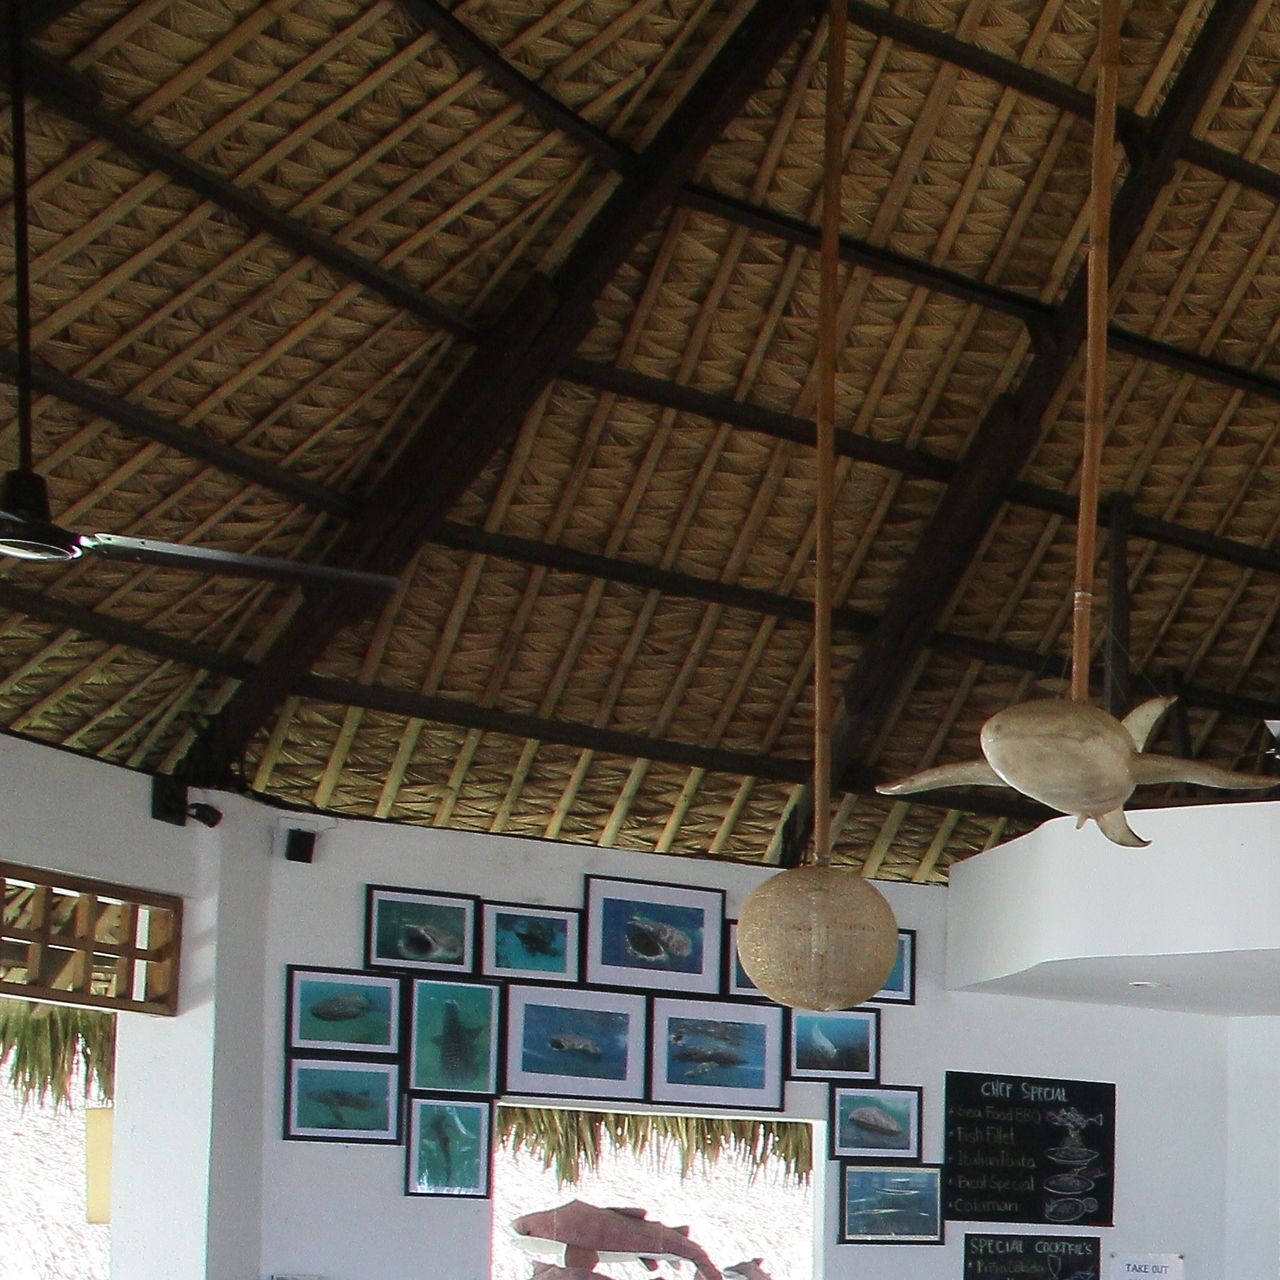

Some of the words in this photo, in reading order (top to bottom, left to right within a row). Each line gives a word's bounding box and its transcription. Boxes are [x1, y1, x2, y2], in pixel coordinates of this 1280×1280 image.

[981, 1080, 1014, 1098] CHEF
[1021, 1082, 1069, 1102] SPECIAL
[986, 1106, 1013, 1121] Food
[956, 1127, 984, 1143] Fish
[970, 1238, 1023, 1254] SPECIAL
[1126, 1264, 1149, 1273] TAKE
[1152, 1264, 1169, 1274] OUT
